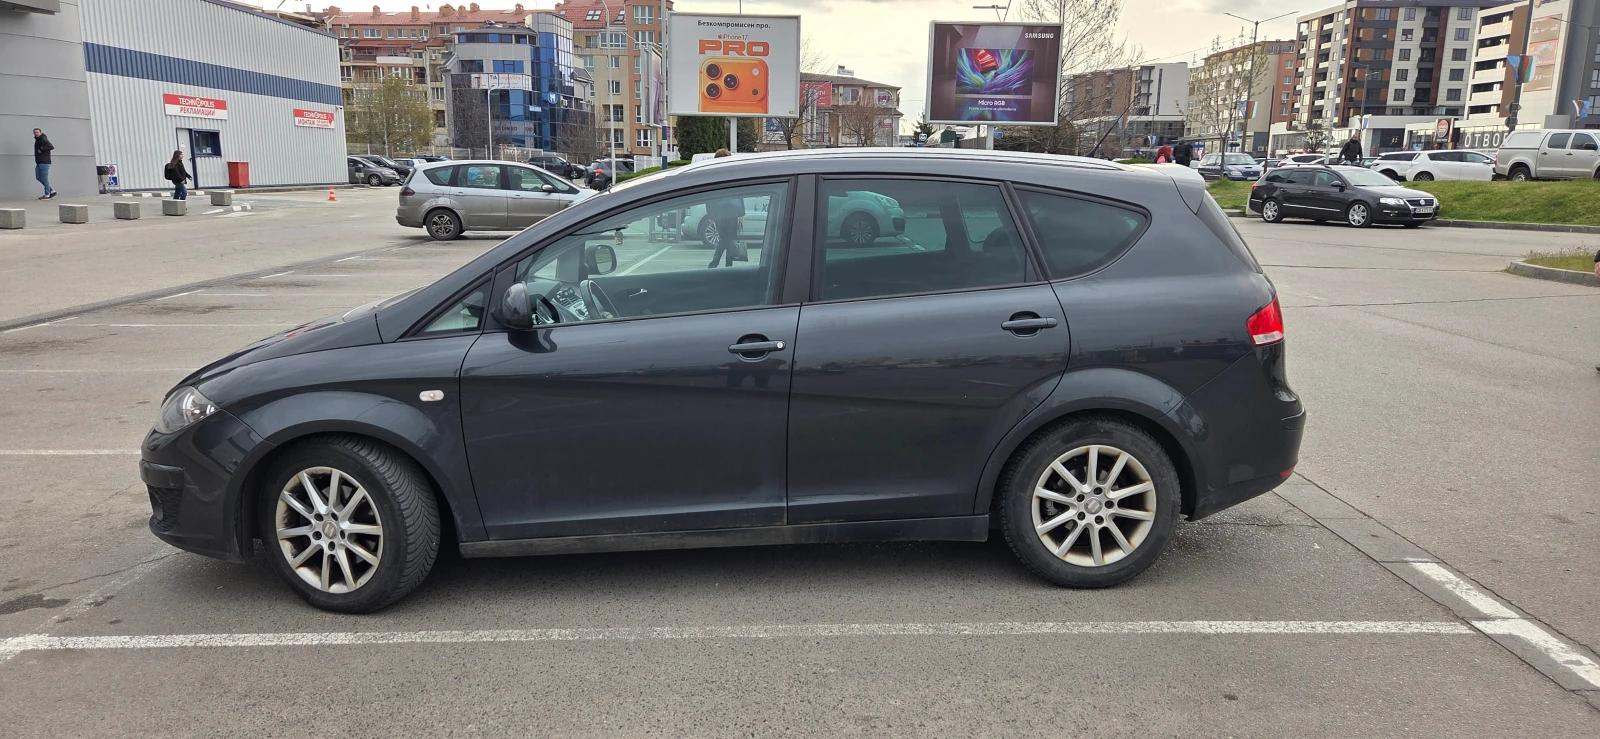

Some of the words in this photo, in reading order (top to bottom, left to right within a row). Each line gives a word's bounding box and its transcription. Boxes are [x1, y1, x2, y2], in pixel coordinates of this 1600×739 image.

[698, 20, 754, 29] Безкомпромисен
[699, 39, 769, 56] PRO
[178, 97, 215, 108] TECHNOPOLIS
[179, 106, 216, 117] РЕКЛАМАЦИИ
